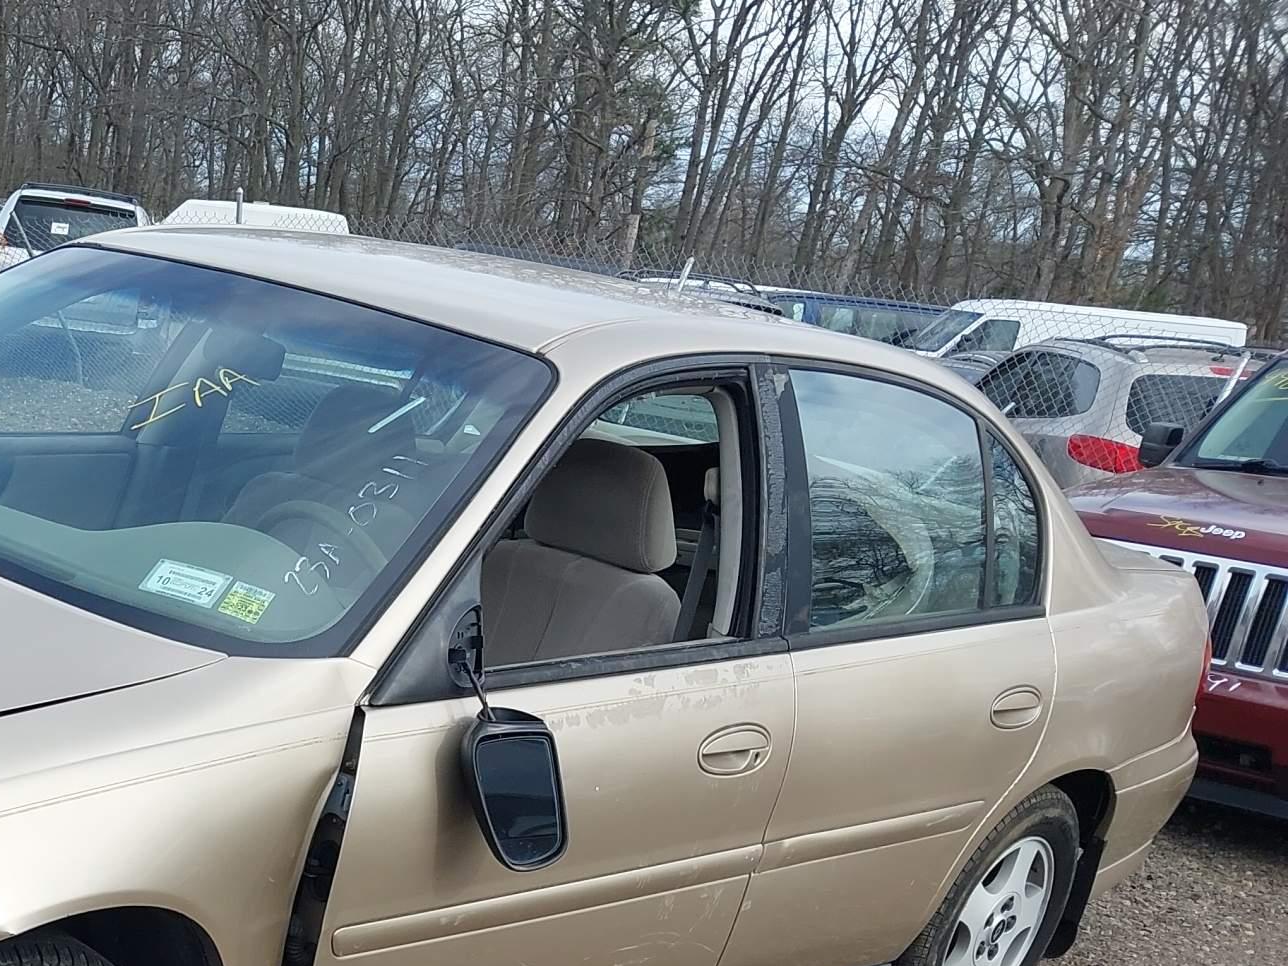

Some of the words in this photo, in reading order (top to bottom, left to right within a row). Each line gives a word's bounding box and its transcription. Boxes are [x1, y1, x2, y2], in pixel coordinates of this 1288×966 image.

[128, 368, 261, 430] IAA
[1199, 525, 1246, 540] Jeep
[155, 575, 171, 586] 10
[197, 586, 215, 598] 24
